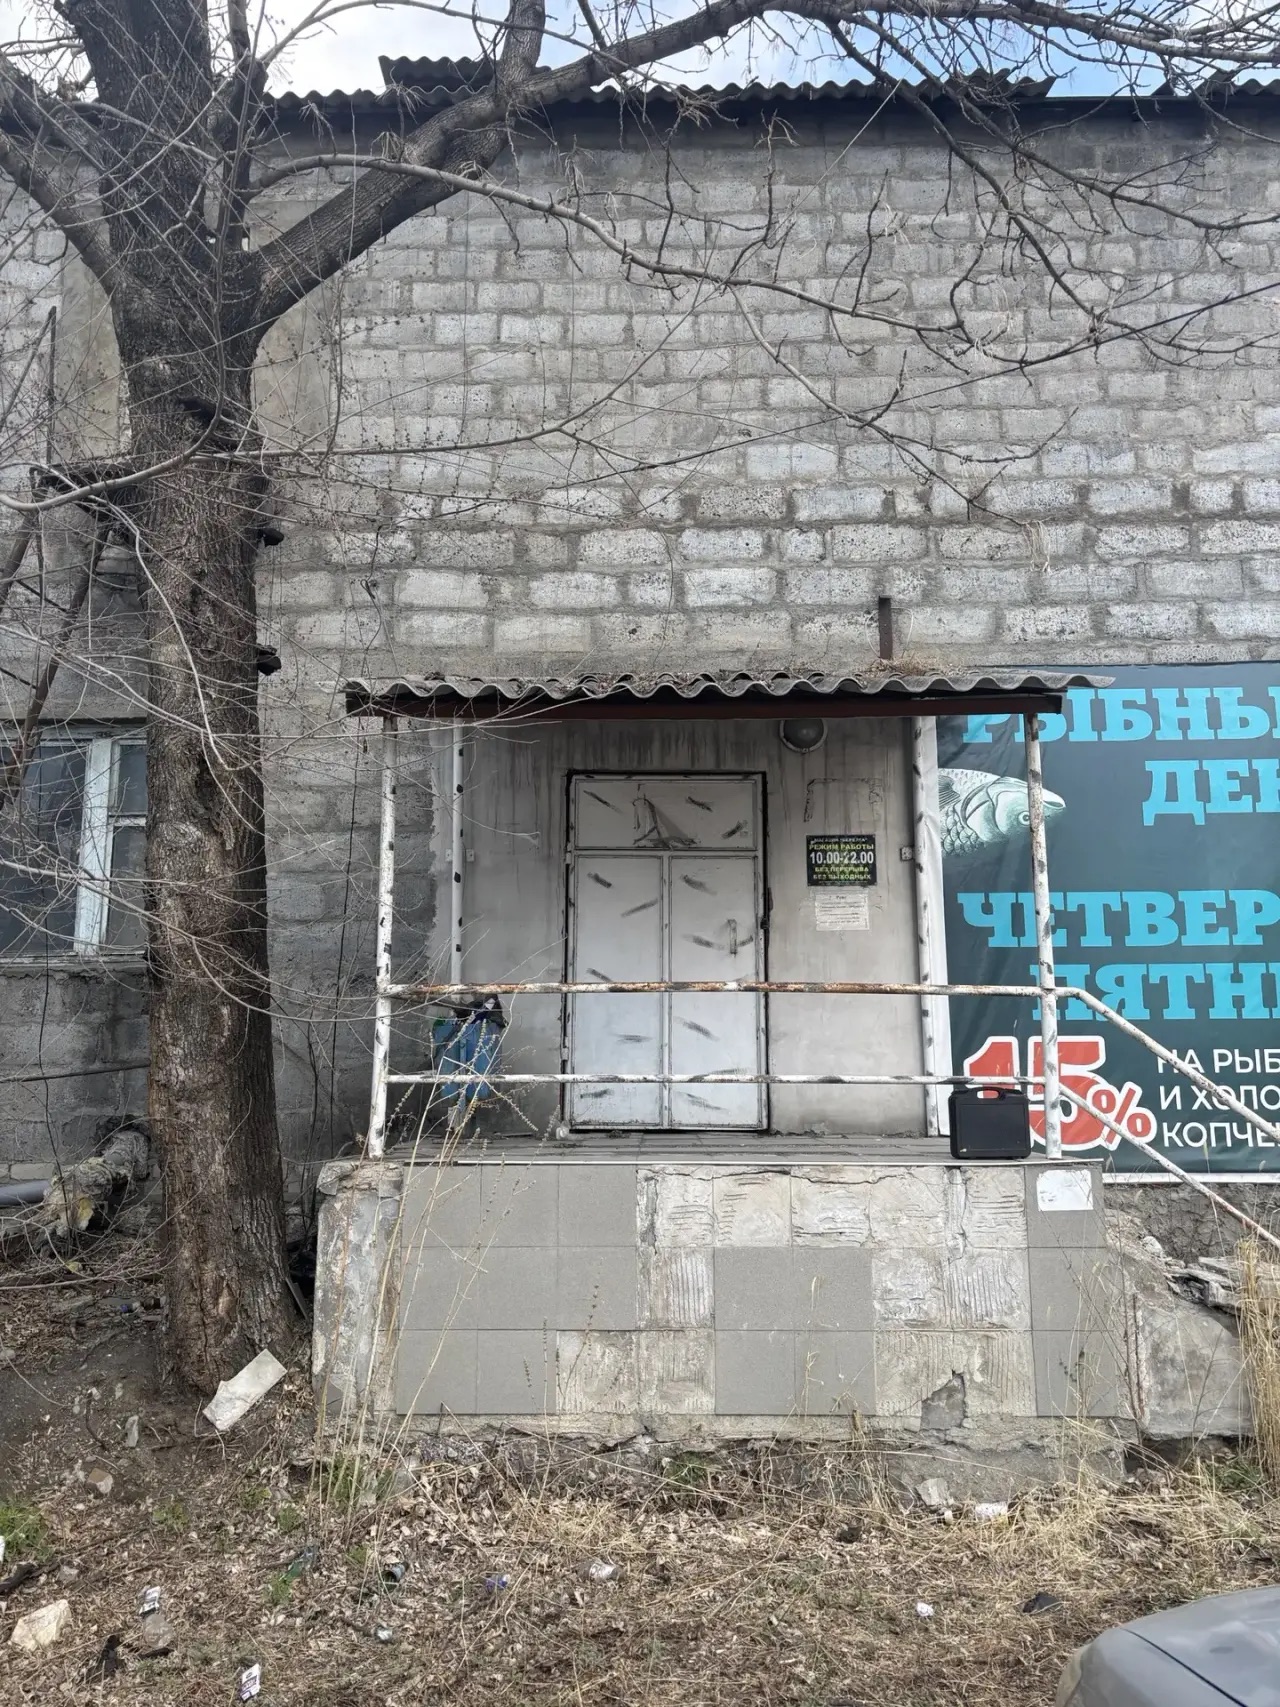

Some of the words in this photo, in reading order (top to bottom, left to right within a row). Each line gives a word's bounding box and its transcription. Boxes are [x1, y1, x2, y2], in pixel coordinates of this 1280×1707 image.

[810, 851, 874, 864] 10.00-22.00
[957, 889, 1280, 948] ЧЕТВЕР
[1029, 962, 1280, 1021] ПЯТН
[1157, 1048, 1206, 1074] НА
[1159, 1085, 1182, 1110] И
[1190, 1084, 1280, 1110] ХОЛО
[1162, 1121, 1280, 1148] КОПЧЕ
